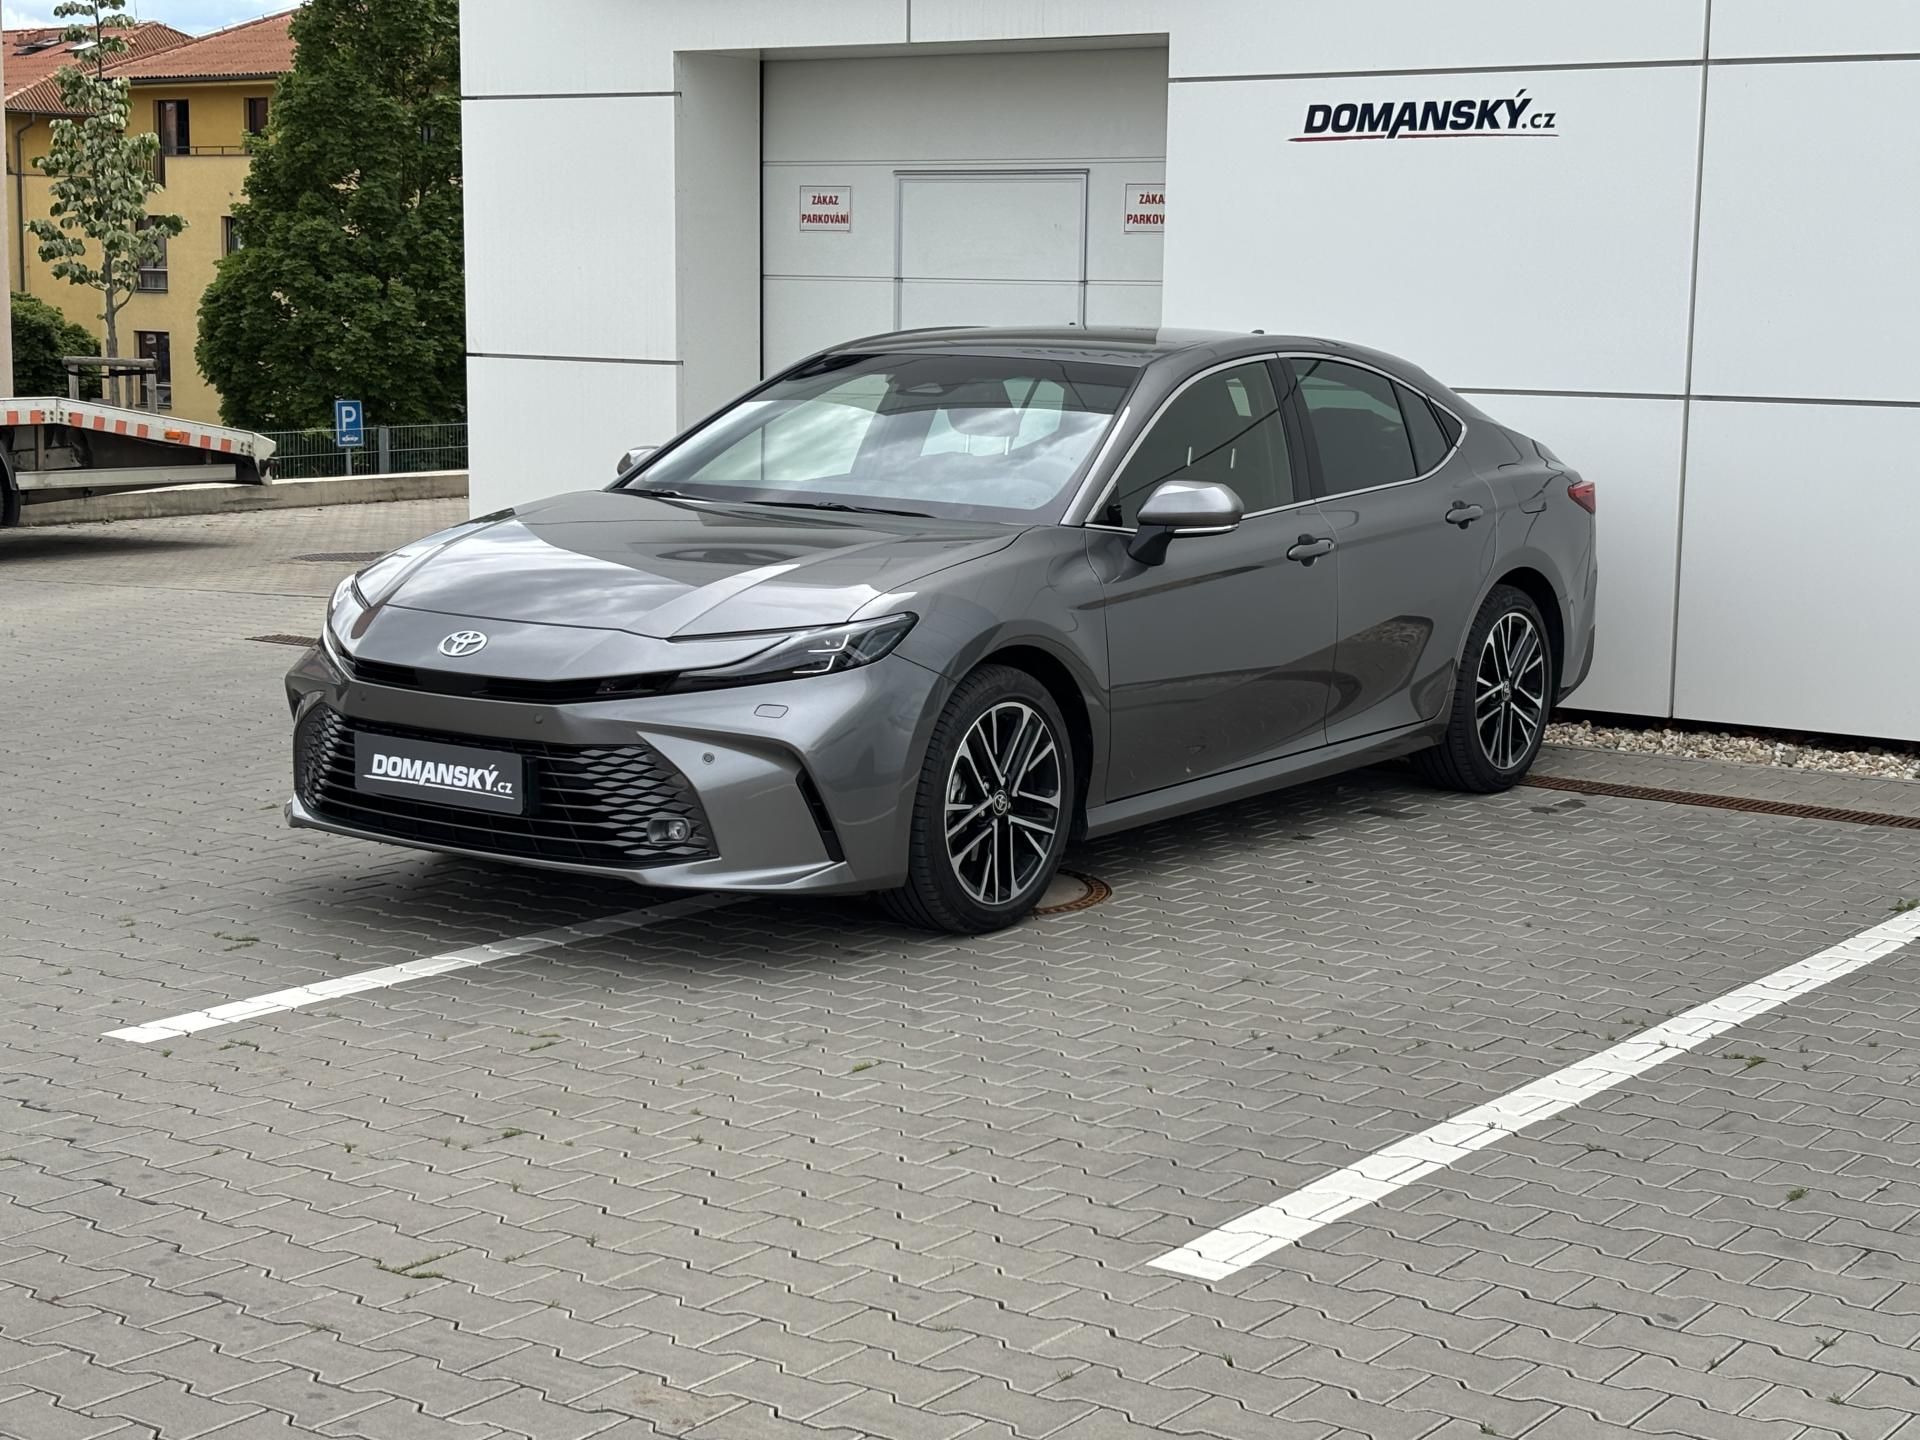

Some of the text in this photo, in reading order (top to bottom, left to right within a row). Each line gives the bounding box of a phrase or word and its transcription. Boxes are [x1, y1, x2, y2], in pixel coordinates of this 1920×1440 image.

[811, 193, 839, 205] ZÁKAZ
[801, 212, 849, 224] PARKOVÁNÍ
[342, 406, 356, 432] P
